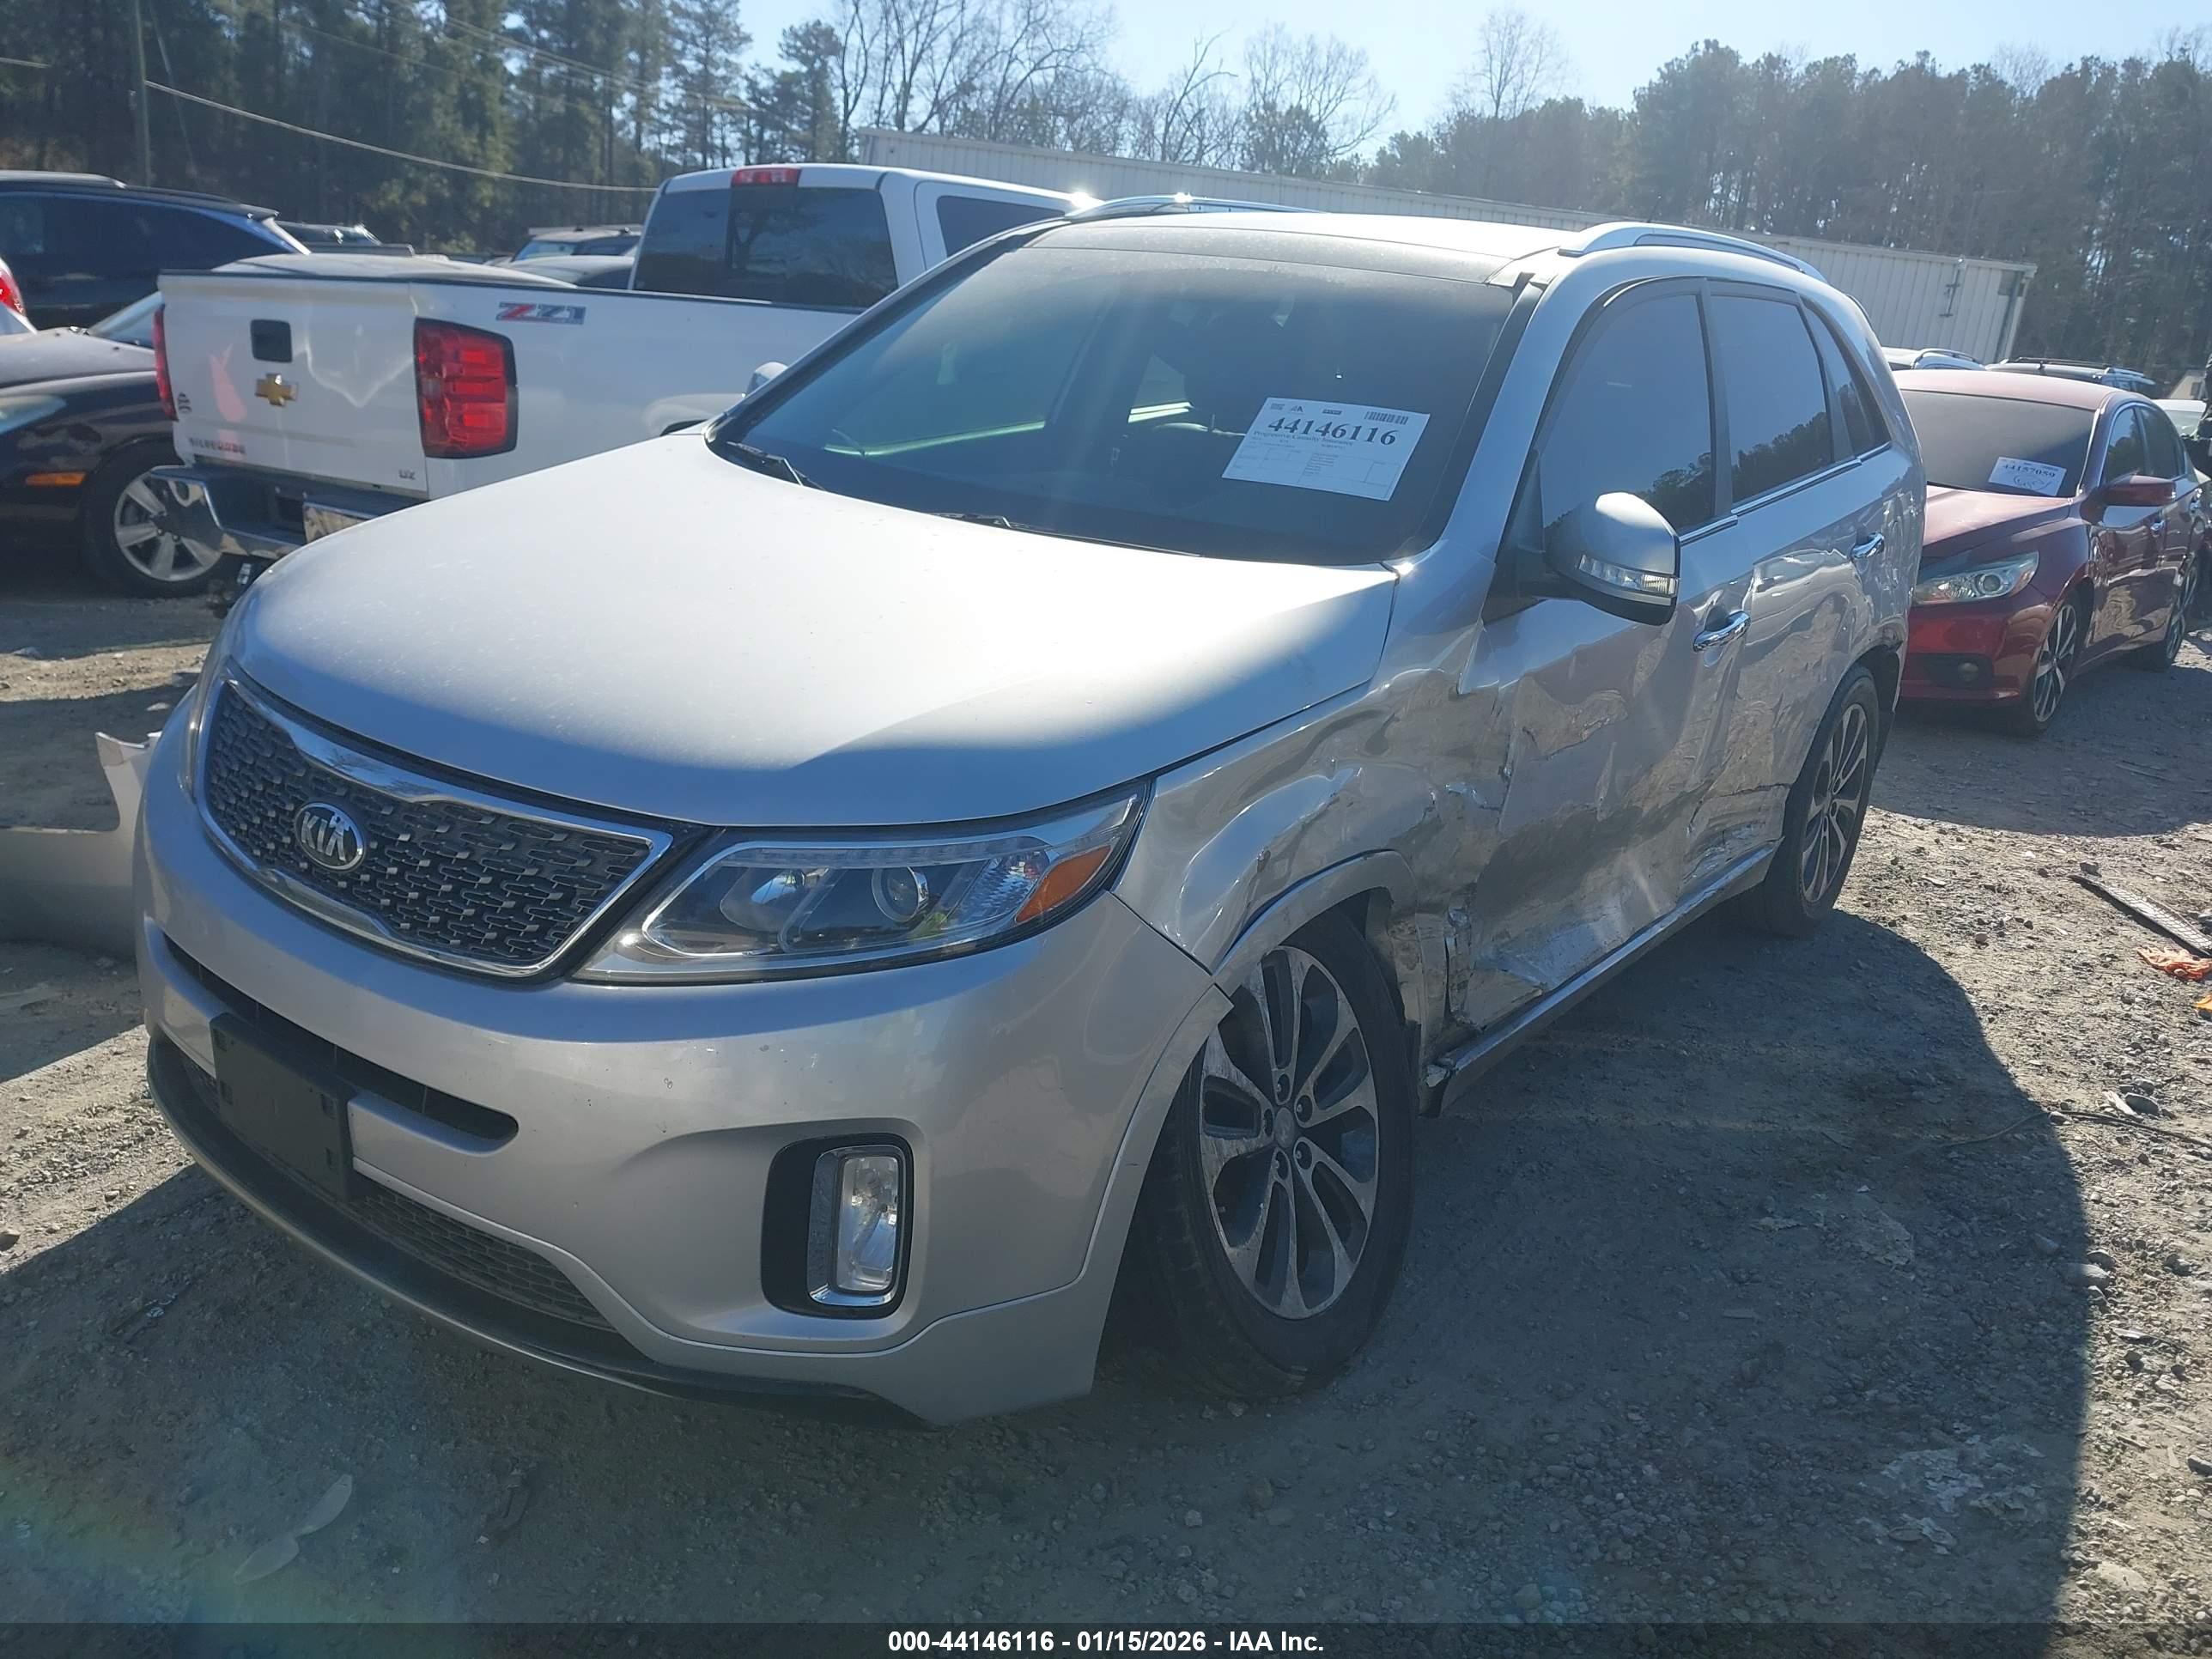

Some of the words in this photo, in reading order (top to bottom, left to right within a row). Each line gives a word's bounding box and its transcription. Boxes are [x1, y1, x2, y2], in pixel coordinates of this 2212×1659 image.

[495, 302, 586, 325] Z71
[1267, 416, 1400, 446] 44146116
[301, 811, 347, 862] KIA
